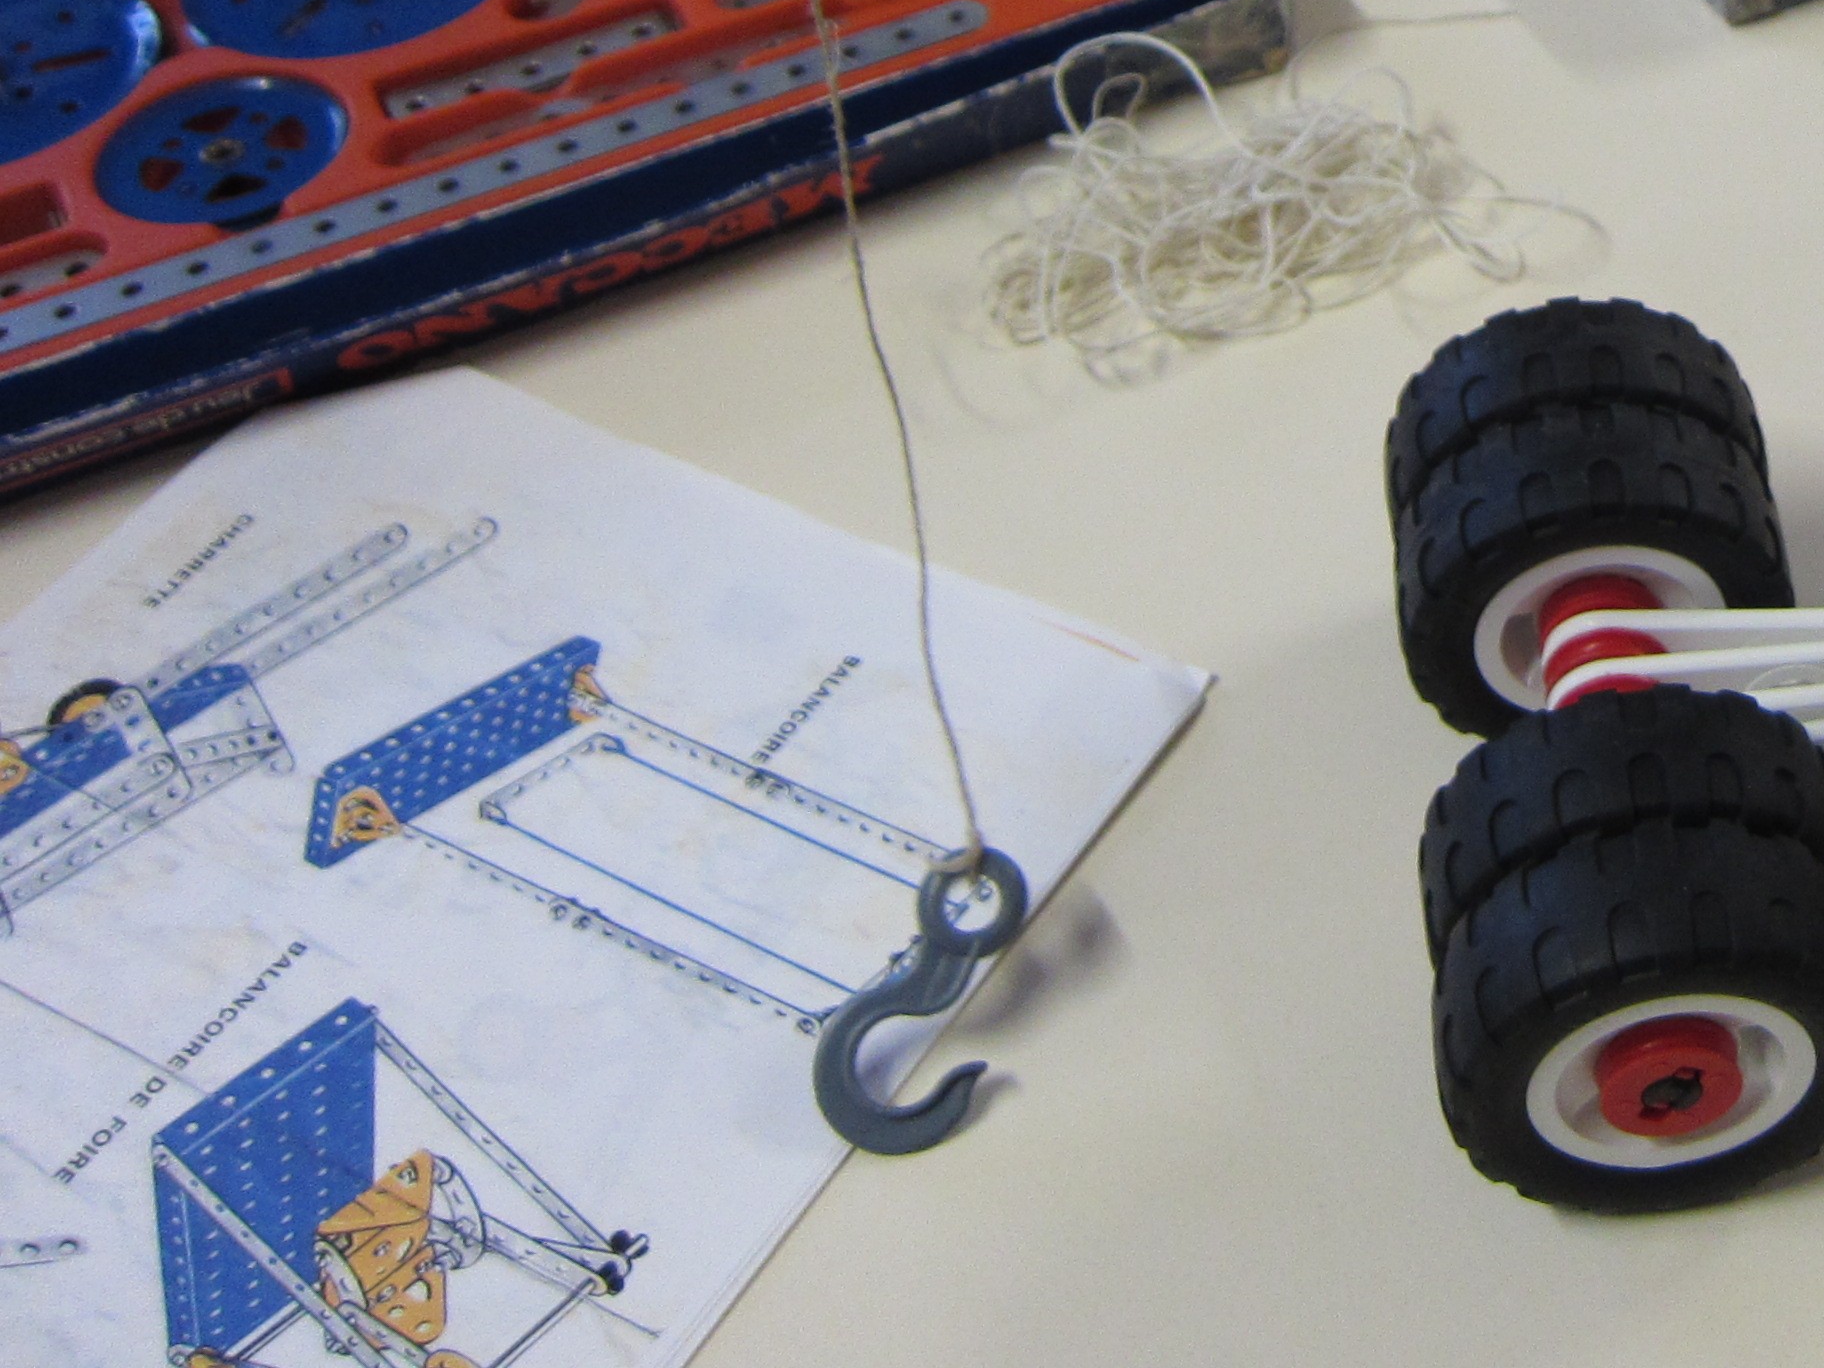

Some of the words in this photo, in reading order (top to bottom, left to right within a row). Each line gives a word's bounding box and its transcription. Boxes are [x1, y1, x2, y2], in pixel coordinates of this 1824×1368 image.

[337, 155, 883, 370] MECCANO
[143, 514, 254, 608] CHARRETTE
[129, 1076, 167, 1108] DE
[54, 1116, 127, 1184] FOIRE
